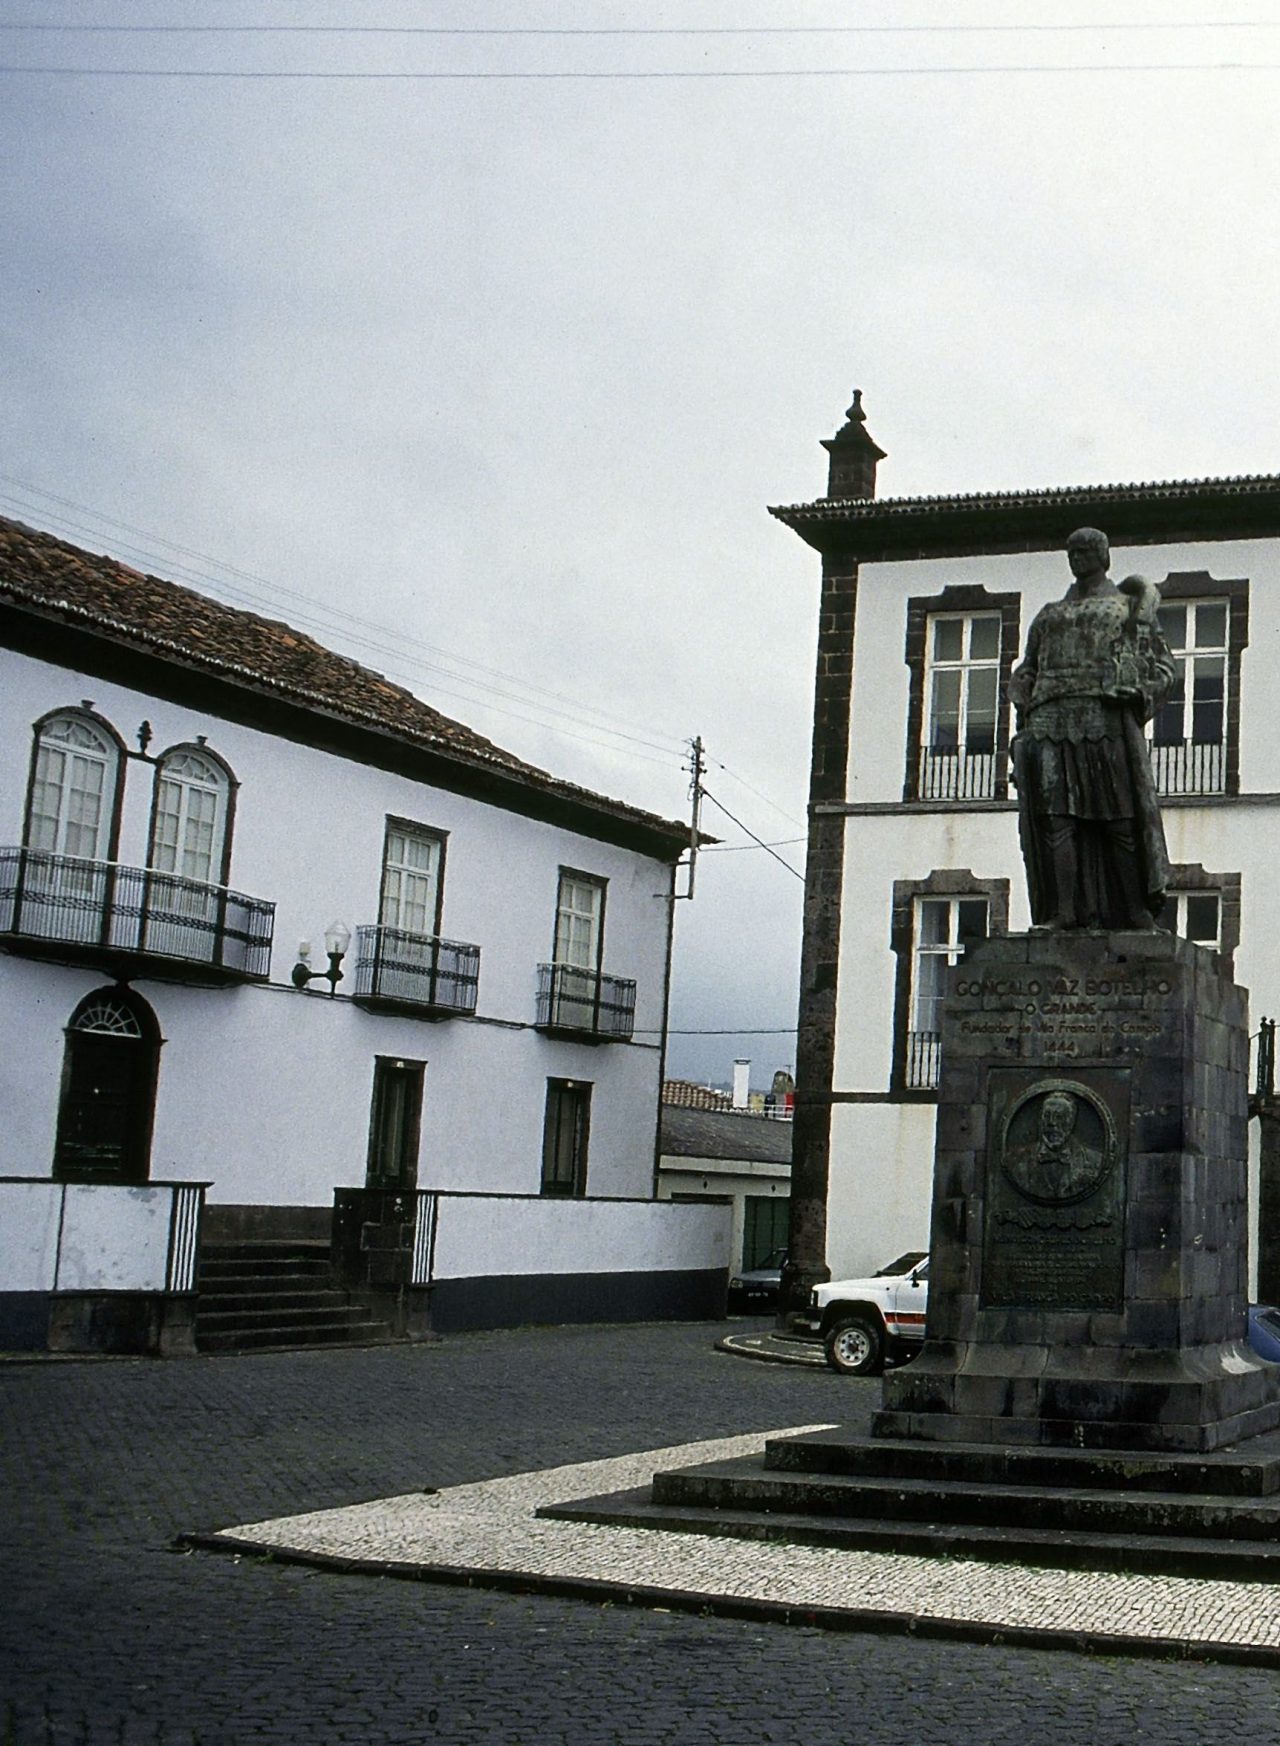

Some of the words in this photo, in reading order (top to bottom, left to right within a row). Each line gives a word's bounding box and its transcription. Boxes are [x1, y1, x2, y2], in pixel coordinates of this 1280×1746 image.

[1085, 980, 1172, 996] BOTELHO
[1025, 1003, 1037, 1015] O
[1040, 1002, 1097, 1015] GRANDE
[961, 1021, 1014, 1035] Fundador
[1058, 1021, 1096, 1035] Franca
[1120, 1020, 1162, 1038] Campo
[1044, 1041, 1076, 1053] 1444
